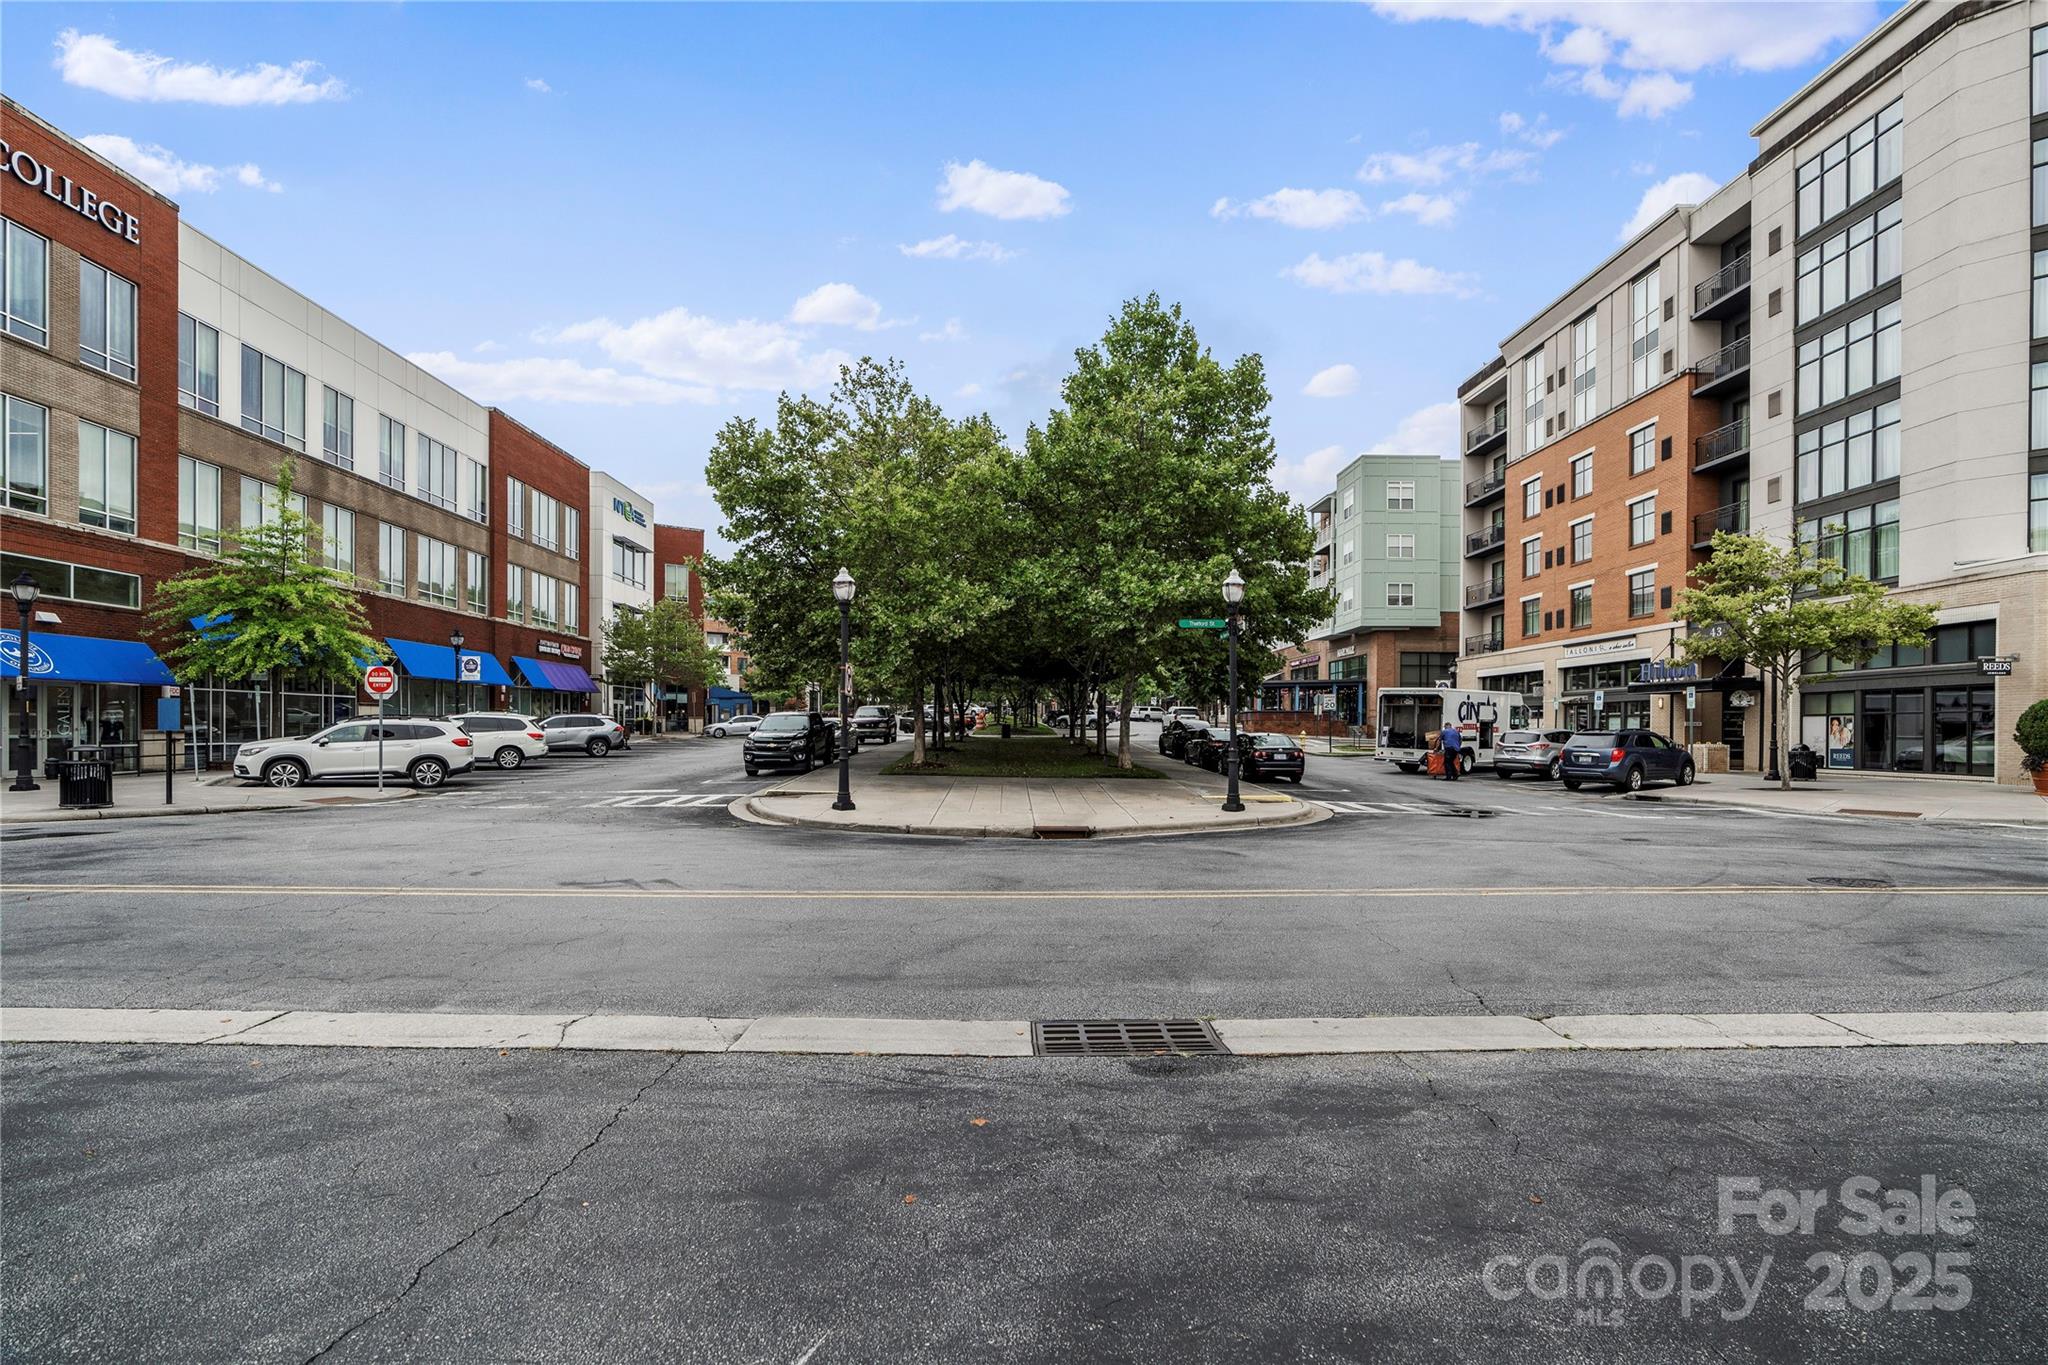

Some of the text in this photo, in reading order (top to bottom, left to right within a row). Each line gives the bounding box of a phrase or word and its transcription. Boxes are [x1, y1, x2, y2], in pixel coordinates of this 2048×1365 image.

[1710, 627, 1722, 637] 43
[1983, 662, 2011, 671] REEDS
[56, 687, 73, 737] GALEN
[1832, 752, 1851, 760] REEDS
